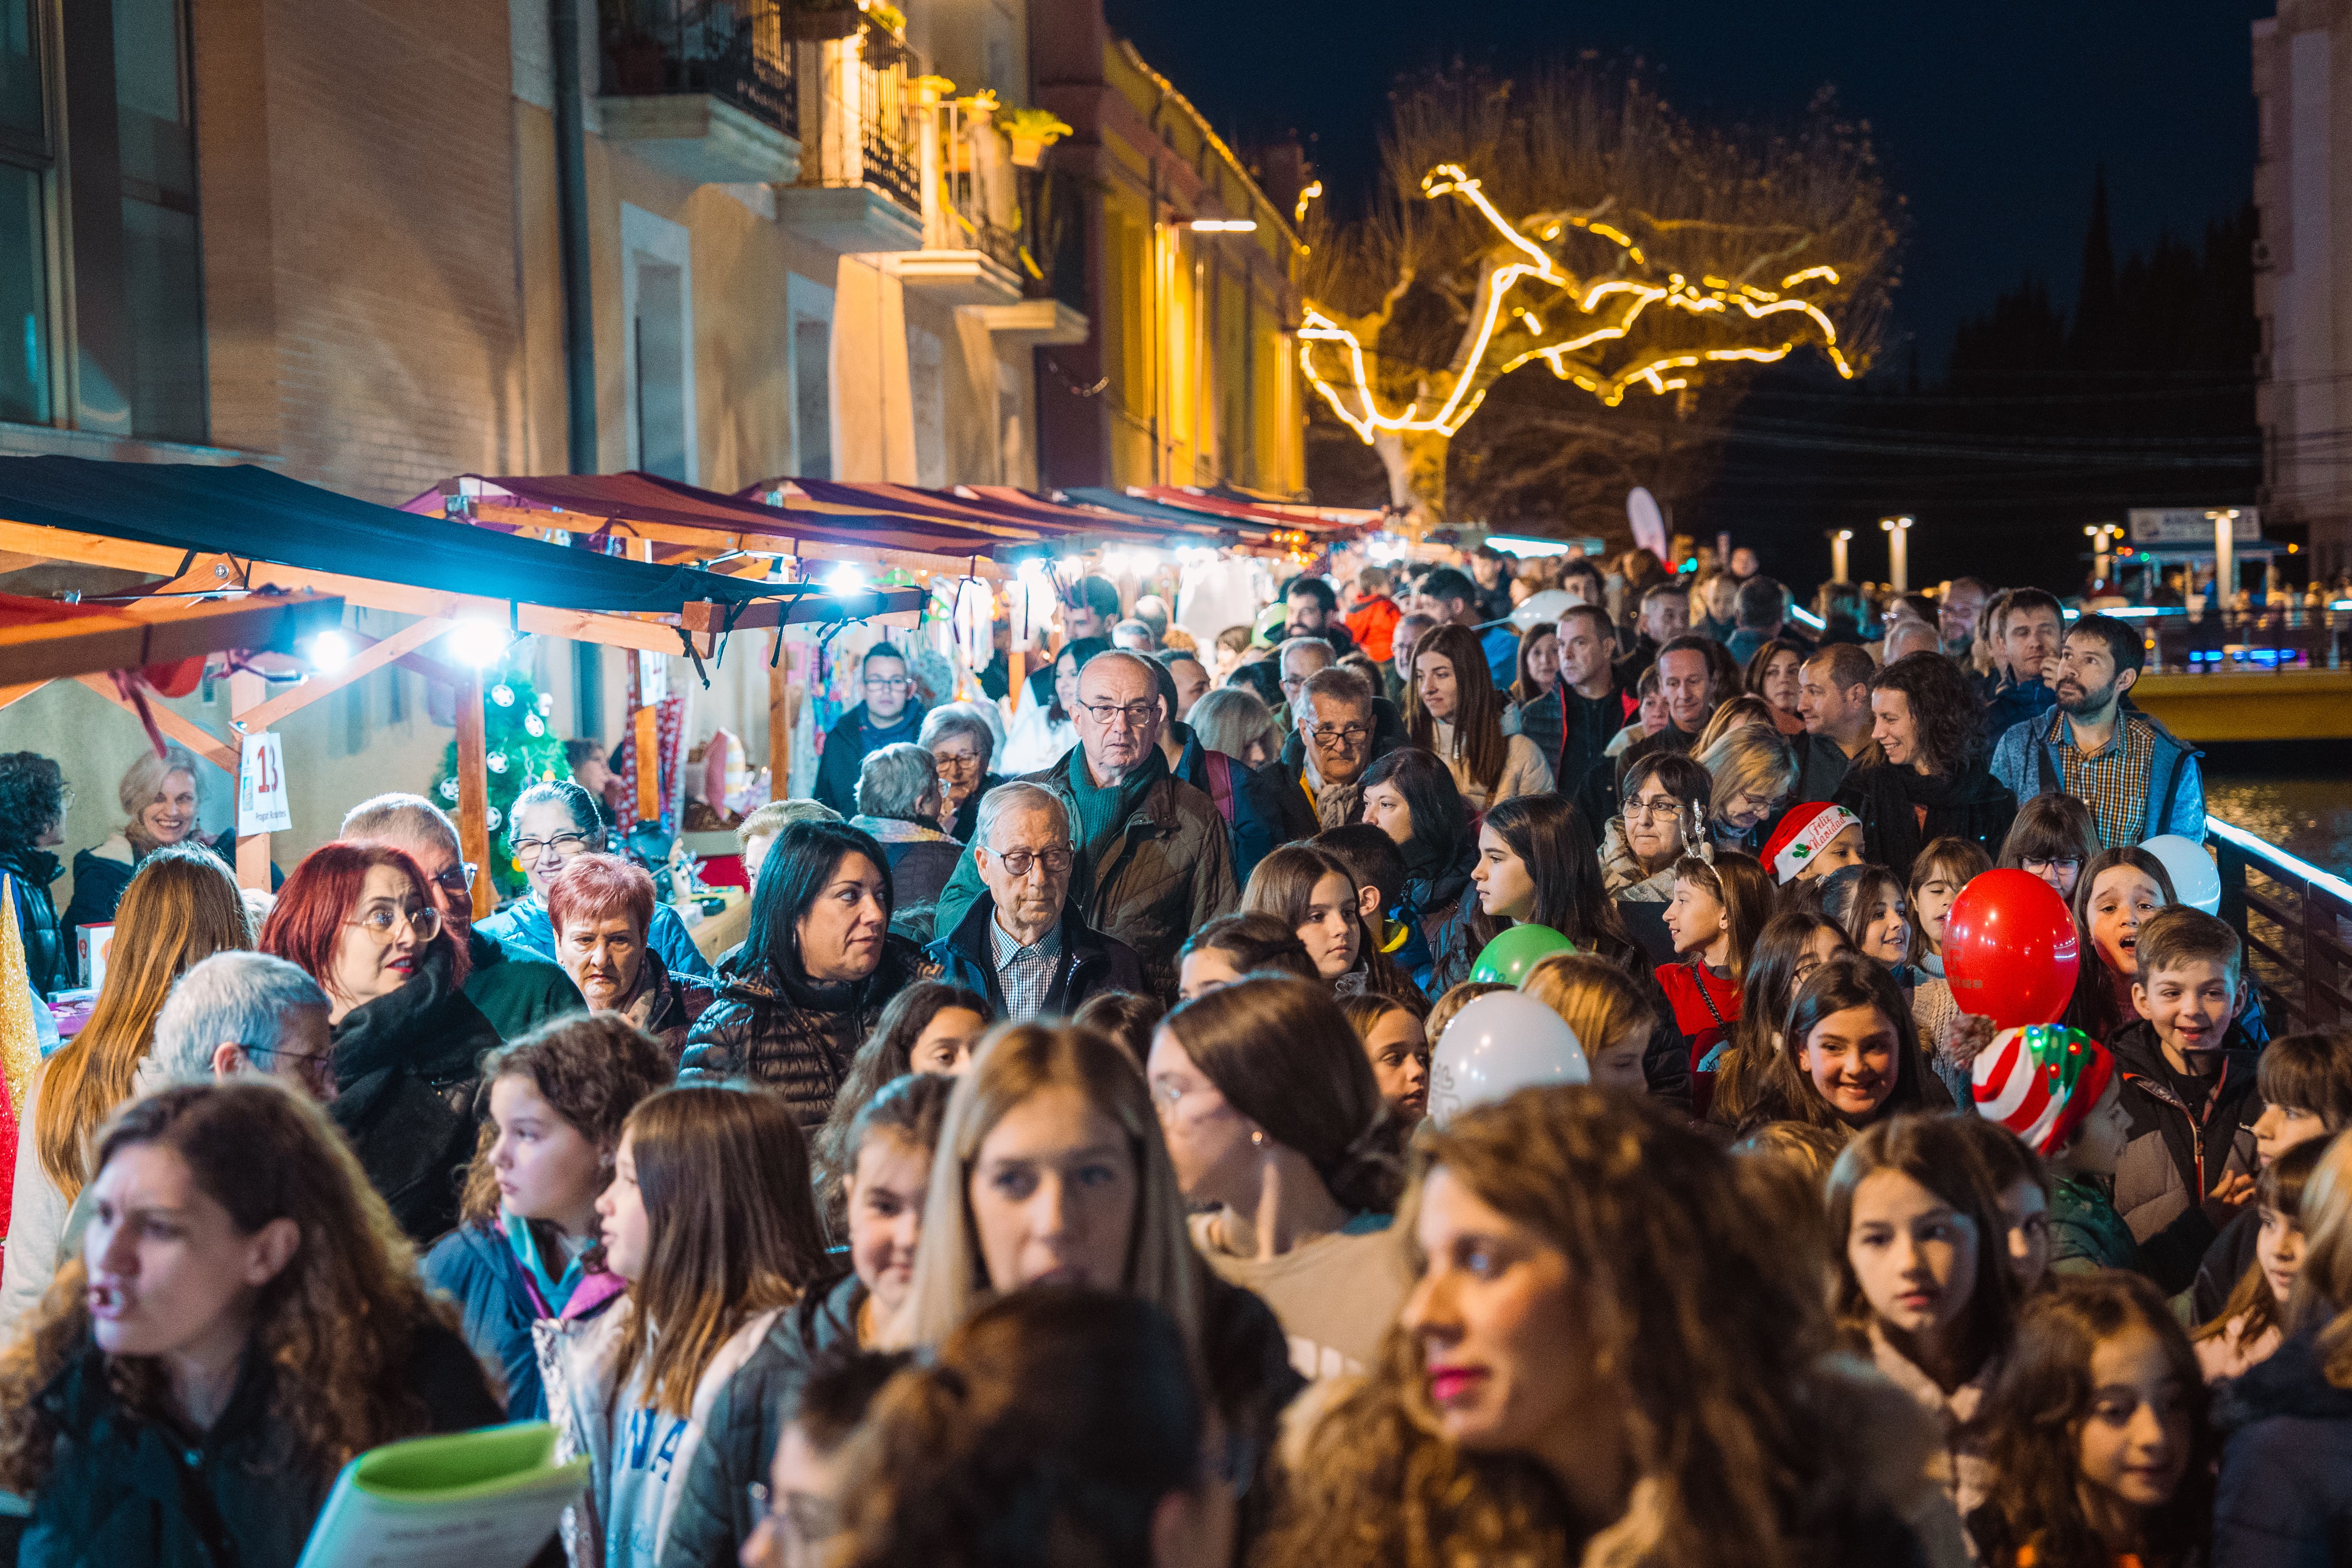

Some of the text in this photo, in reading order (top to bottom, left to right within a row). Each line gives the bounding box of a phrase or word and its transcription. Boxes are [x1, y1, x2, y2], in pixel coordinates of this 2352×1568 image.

[258, 745, 278, 793] 13
[1808, 814, 1832, 836] Feliz
[1809, 813, 1846, 850] Navidad
